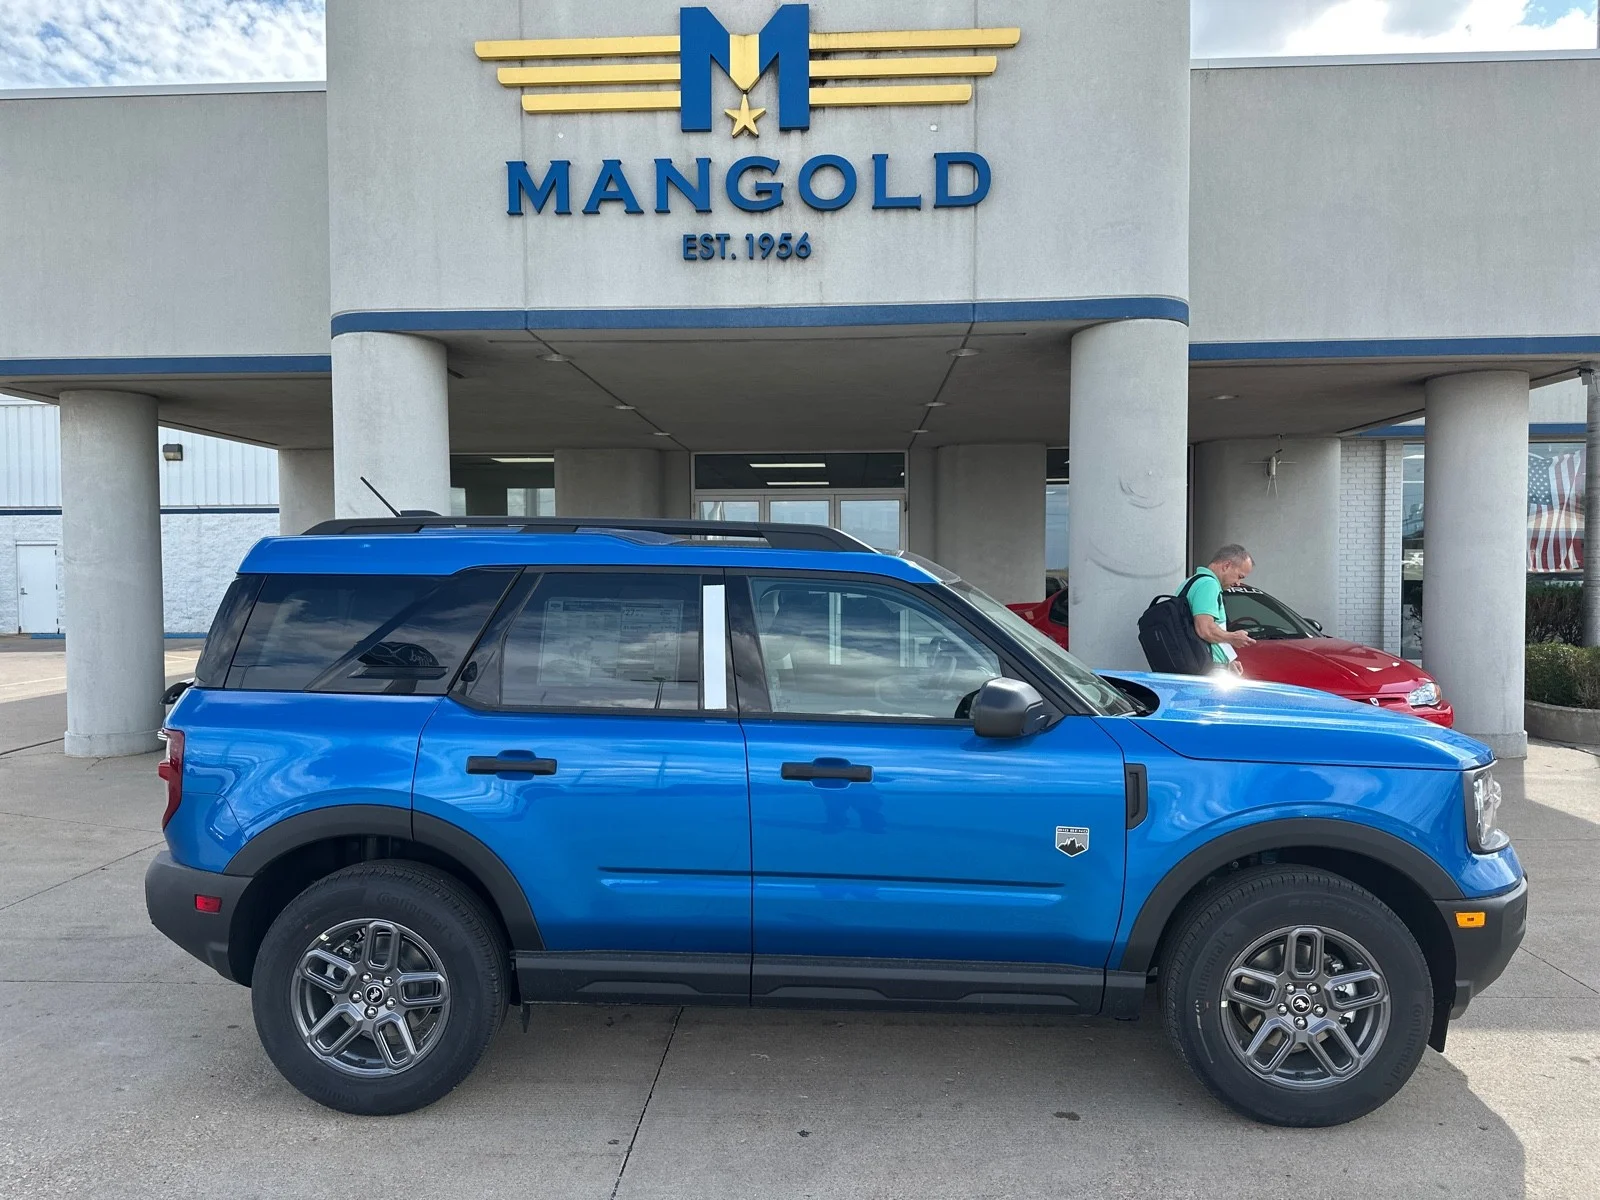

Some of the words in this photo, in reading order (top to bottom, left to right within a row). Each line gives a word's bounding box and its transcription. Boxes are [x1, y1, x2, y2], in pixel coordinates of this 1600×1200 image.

[680, 4, 810, 133] M
[506, 151, 992, 216] MANGOLD
[682, 234, 736, 261] EST.
[745, 231, 812, 260] 1956
